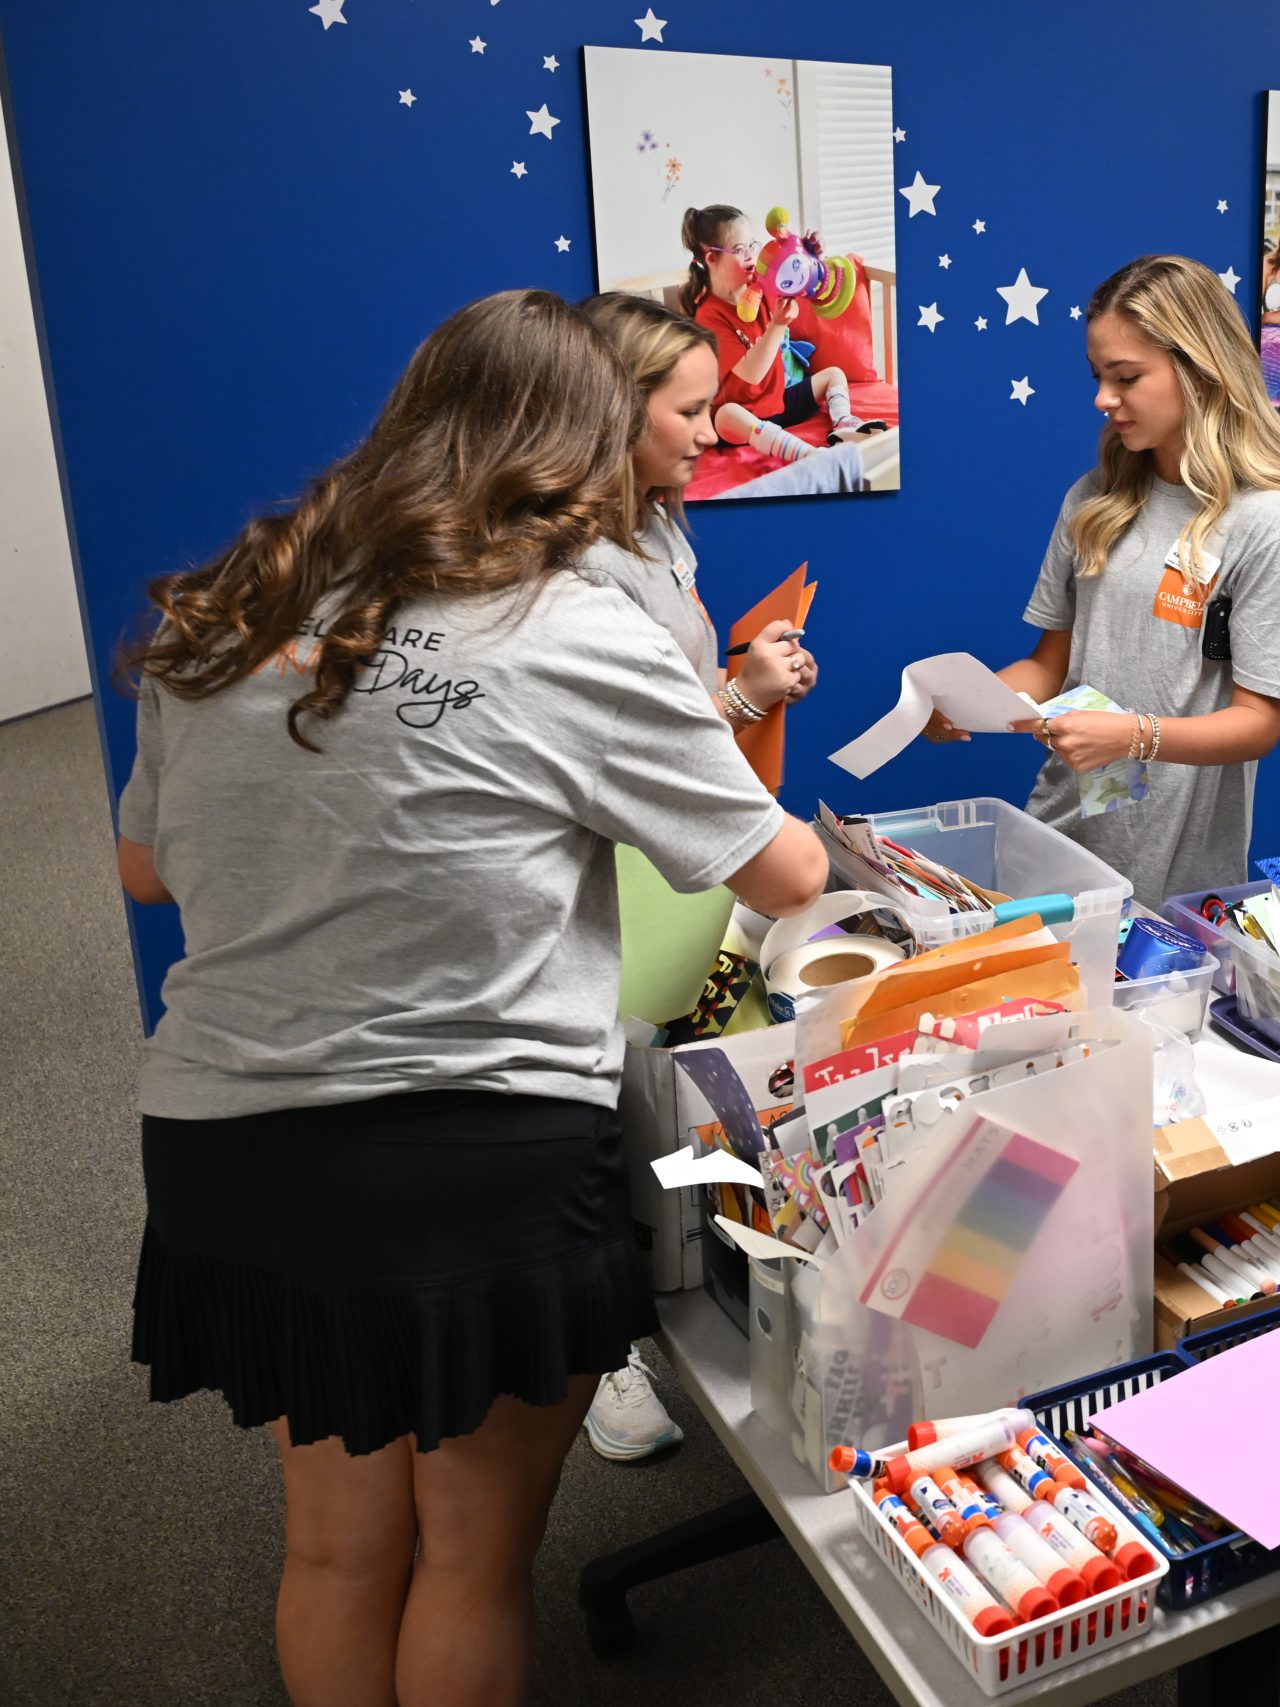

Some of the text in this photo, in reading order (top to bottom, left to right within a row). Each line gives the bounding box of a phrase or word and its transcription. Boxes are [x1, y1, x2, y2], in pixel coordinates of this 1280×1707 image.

[1159, 591, 1204, 611] CAMPBEL
[384, 626, 446, 652] ARE
[353, 649, 486, 729] Days
